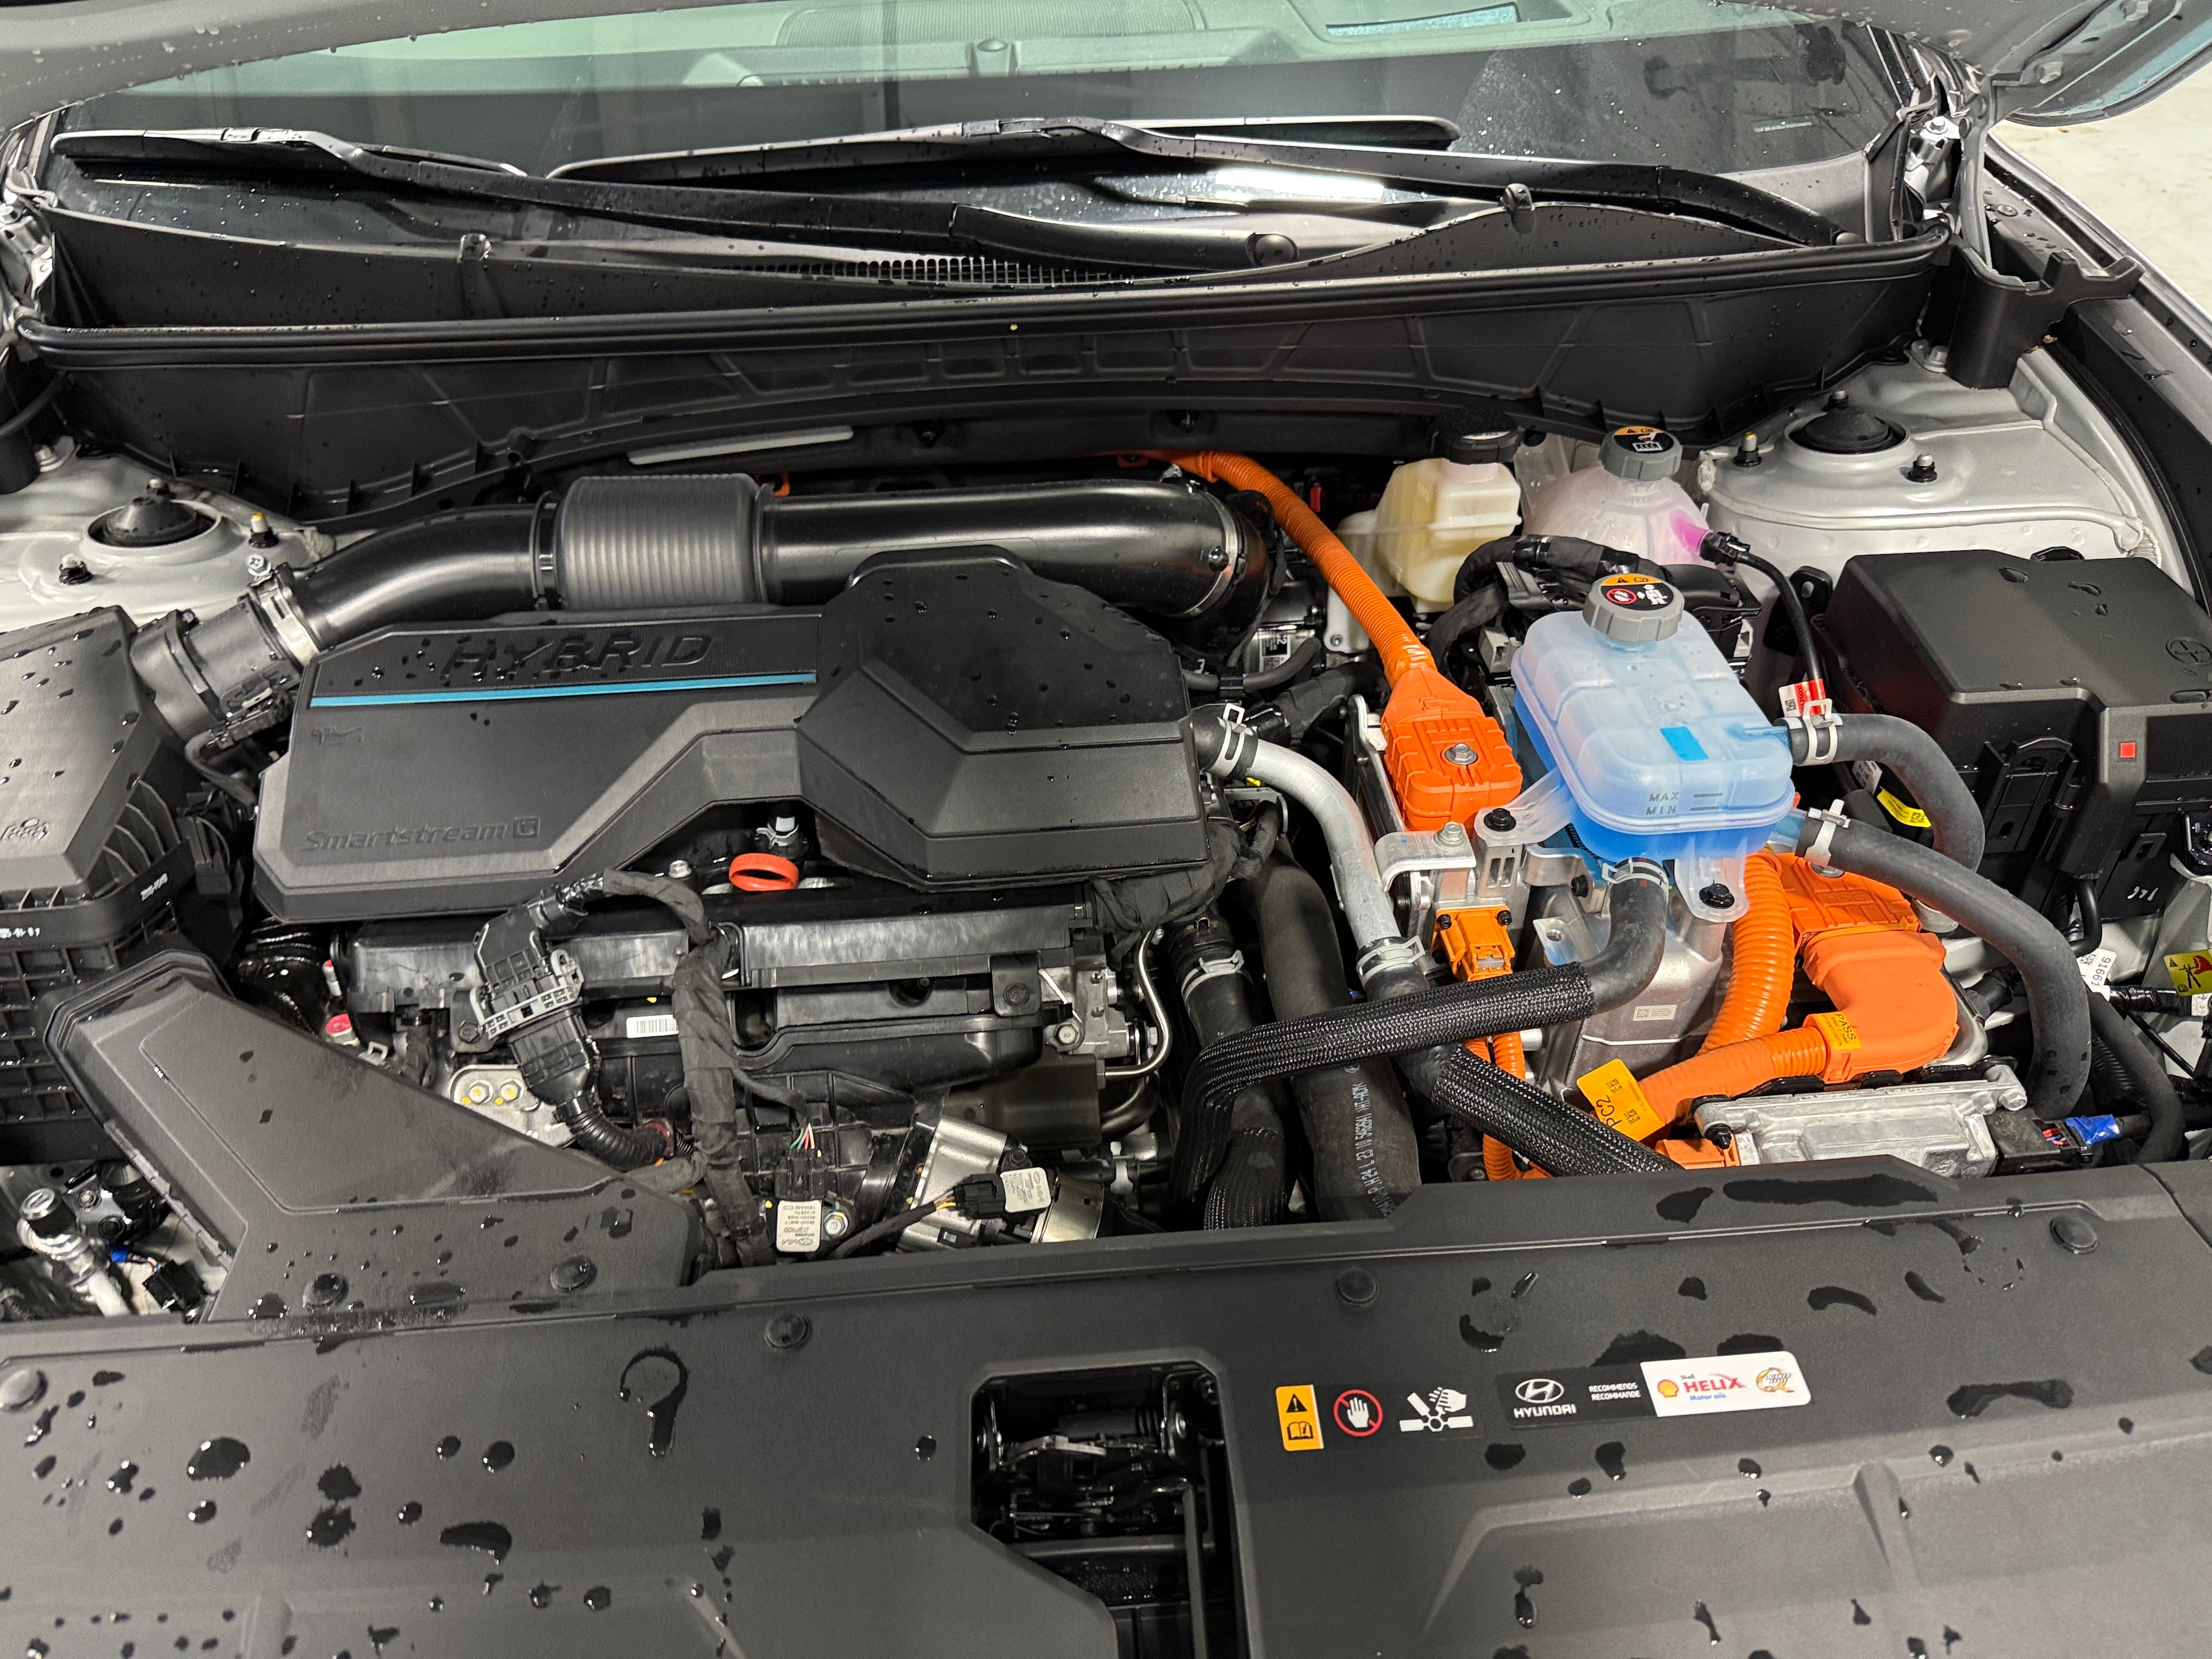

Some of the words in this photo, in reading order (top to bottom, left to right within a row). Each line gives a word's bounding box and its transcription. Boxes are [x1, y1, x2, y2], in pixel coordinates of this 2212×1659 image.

[441, 634, 713, 678] HYBRID
[1649, 792, 1679, 802] MAX
[1646, 805, 1677, 815] MIN
[305, 824, 509, 849] Smartstream
[1835, 1014, 1857, 1040] PASS
[1596, 1094, 1622, 1127] PC2
[1589, 1382, 1639, 1393] RECOMMENDS
[1683, 1377, 1745, 1393] HELIX
[1591, 1390, 1641, 1401] RECOMMANDE
[1513, 1403, 1577, 1419] HYUNDAI
